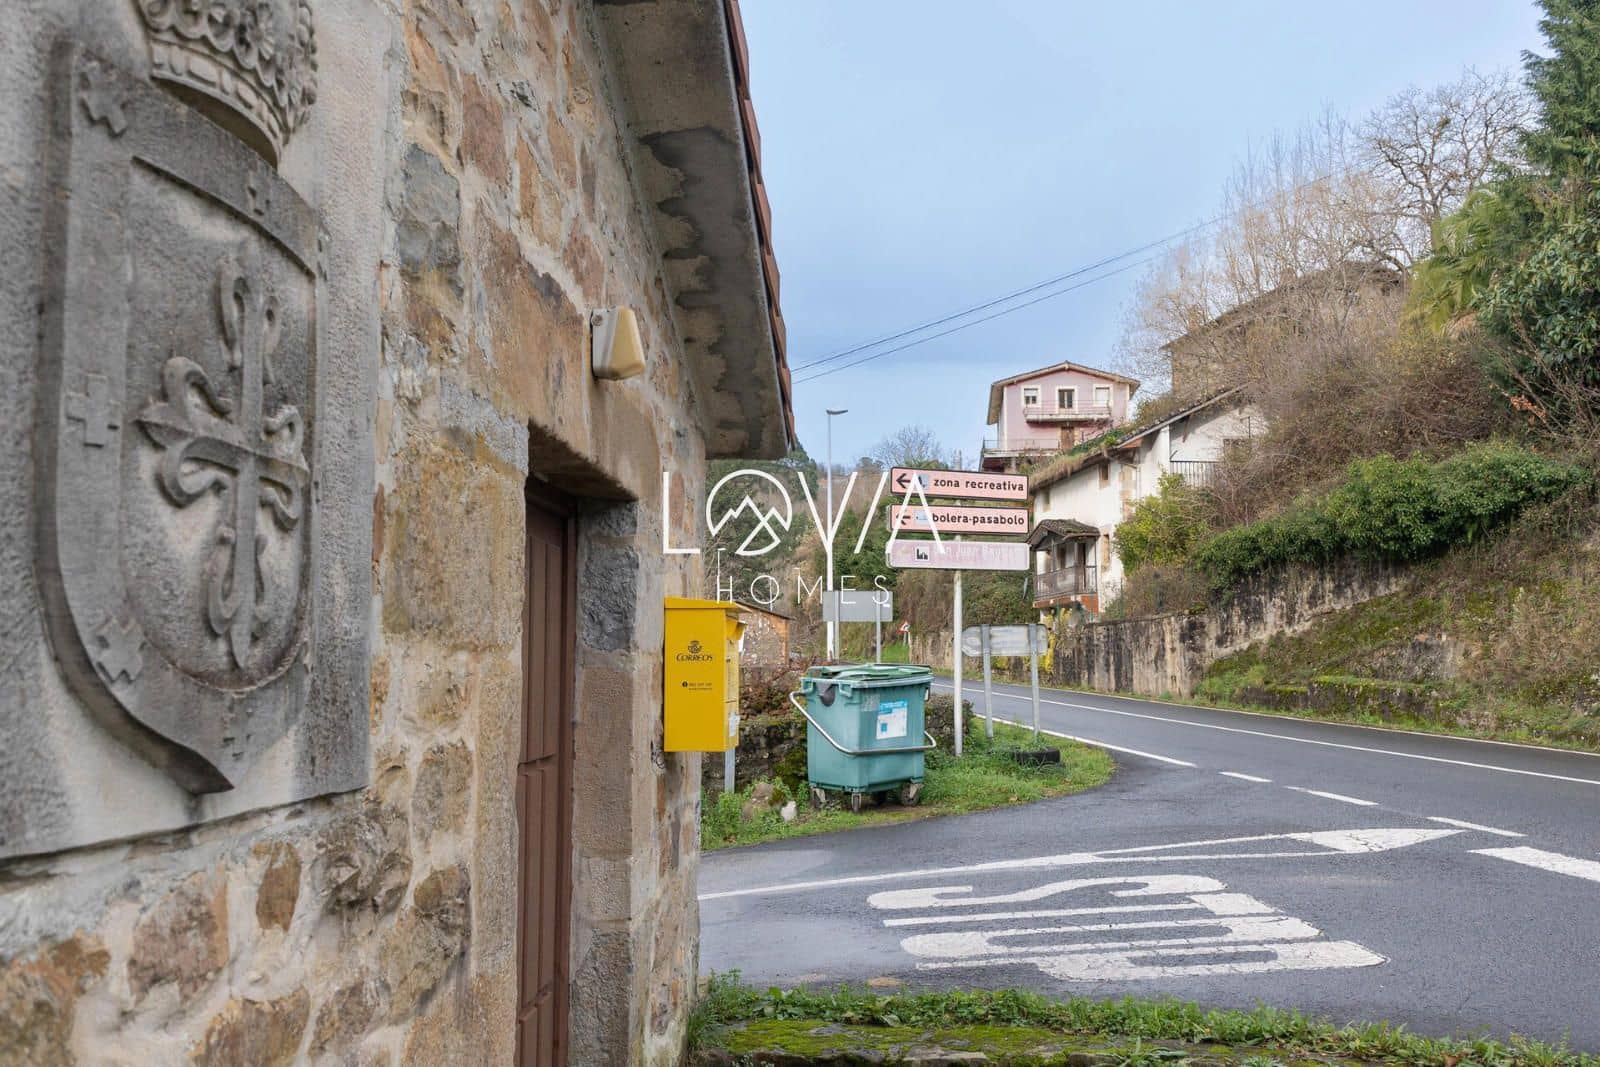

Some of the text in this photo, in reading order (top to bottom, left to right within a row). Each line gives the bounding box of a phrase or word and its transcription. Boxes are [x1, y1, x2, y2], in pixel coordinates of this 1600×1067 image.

[933, 478, 1024, 492] zona recreativa
[932, 513, 1025, 526] bolera-pasabolo
[866, 874, 1391, 982] STOP
